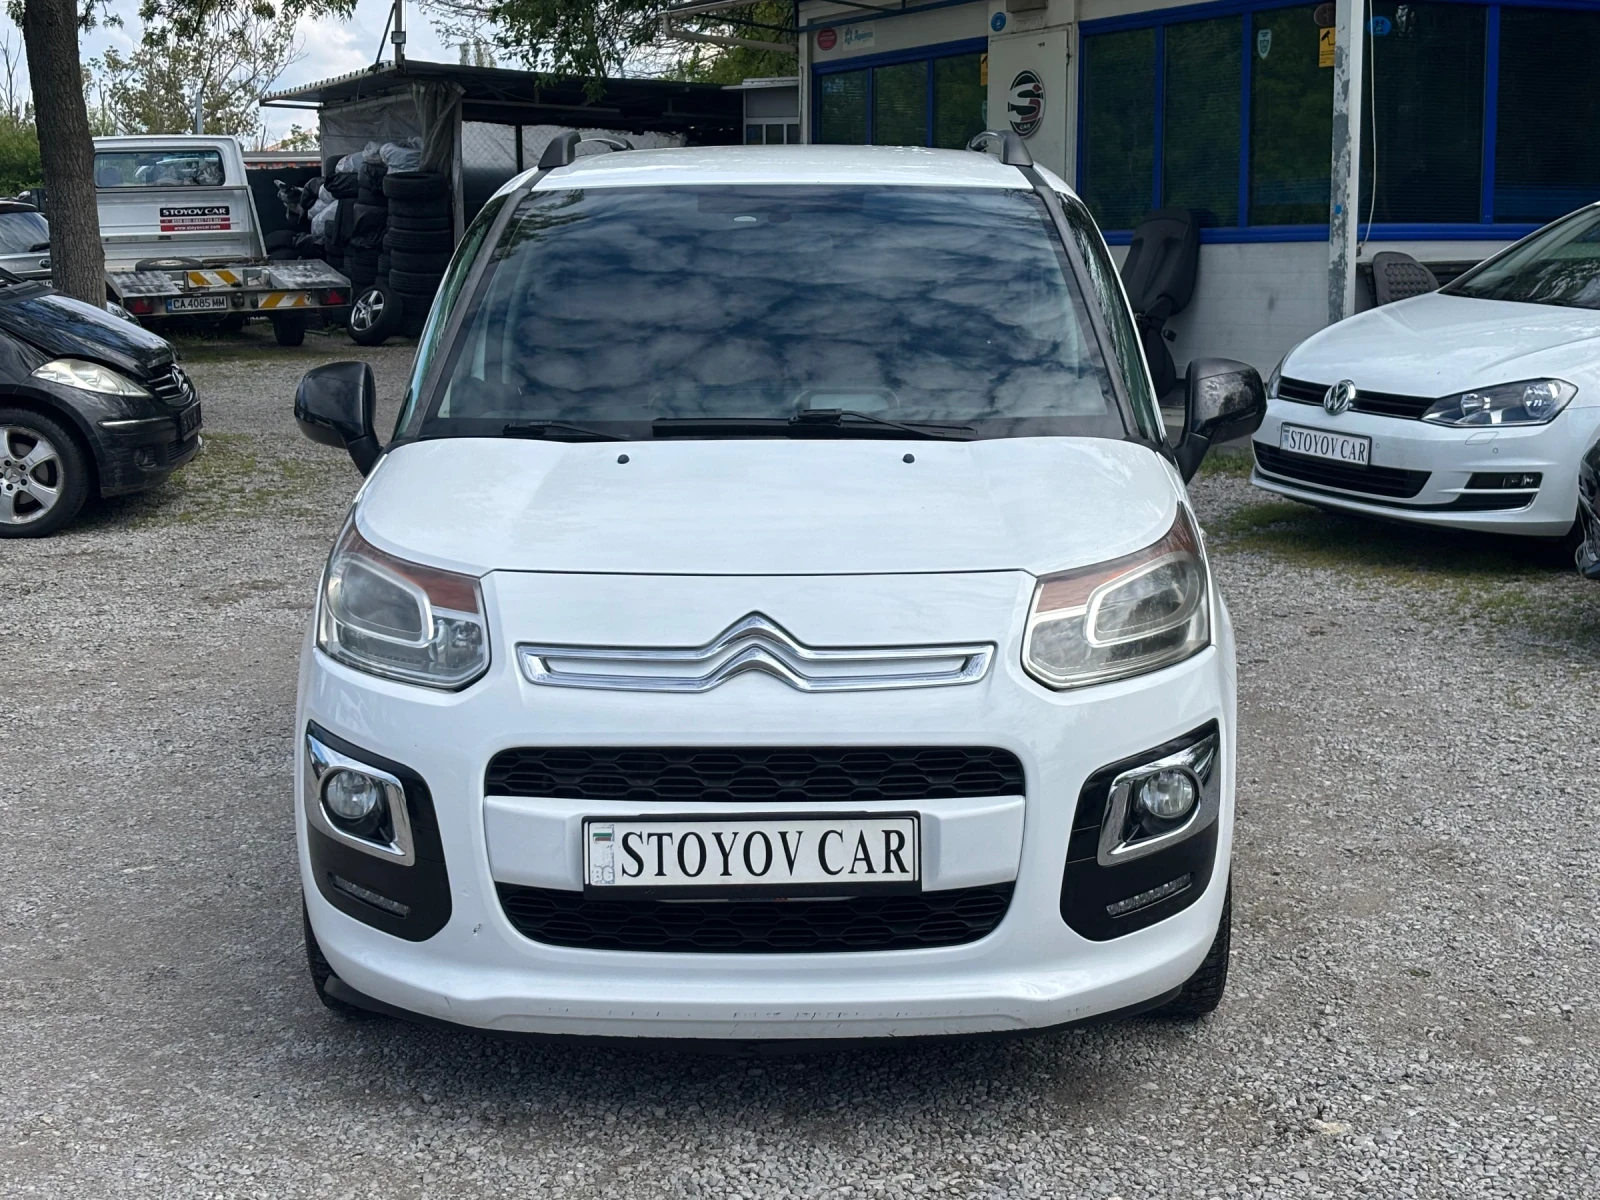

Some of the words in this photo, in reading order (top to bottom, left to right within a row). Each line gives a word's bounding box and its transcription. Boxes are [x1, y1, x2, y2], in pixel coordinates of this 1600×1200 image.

[1289, 430, 1339, 456] STOYOV
[1340, 439, 1366, 462] CAR
[621, 830, 804, 878] STOYOV
[817, 829, 910, 876] CAR
